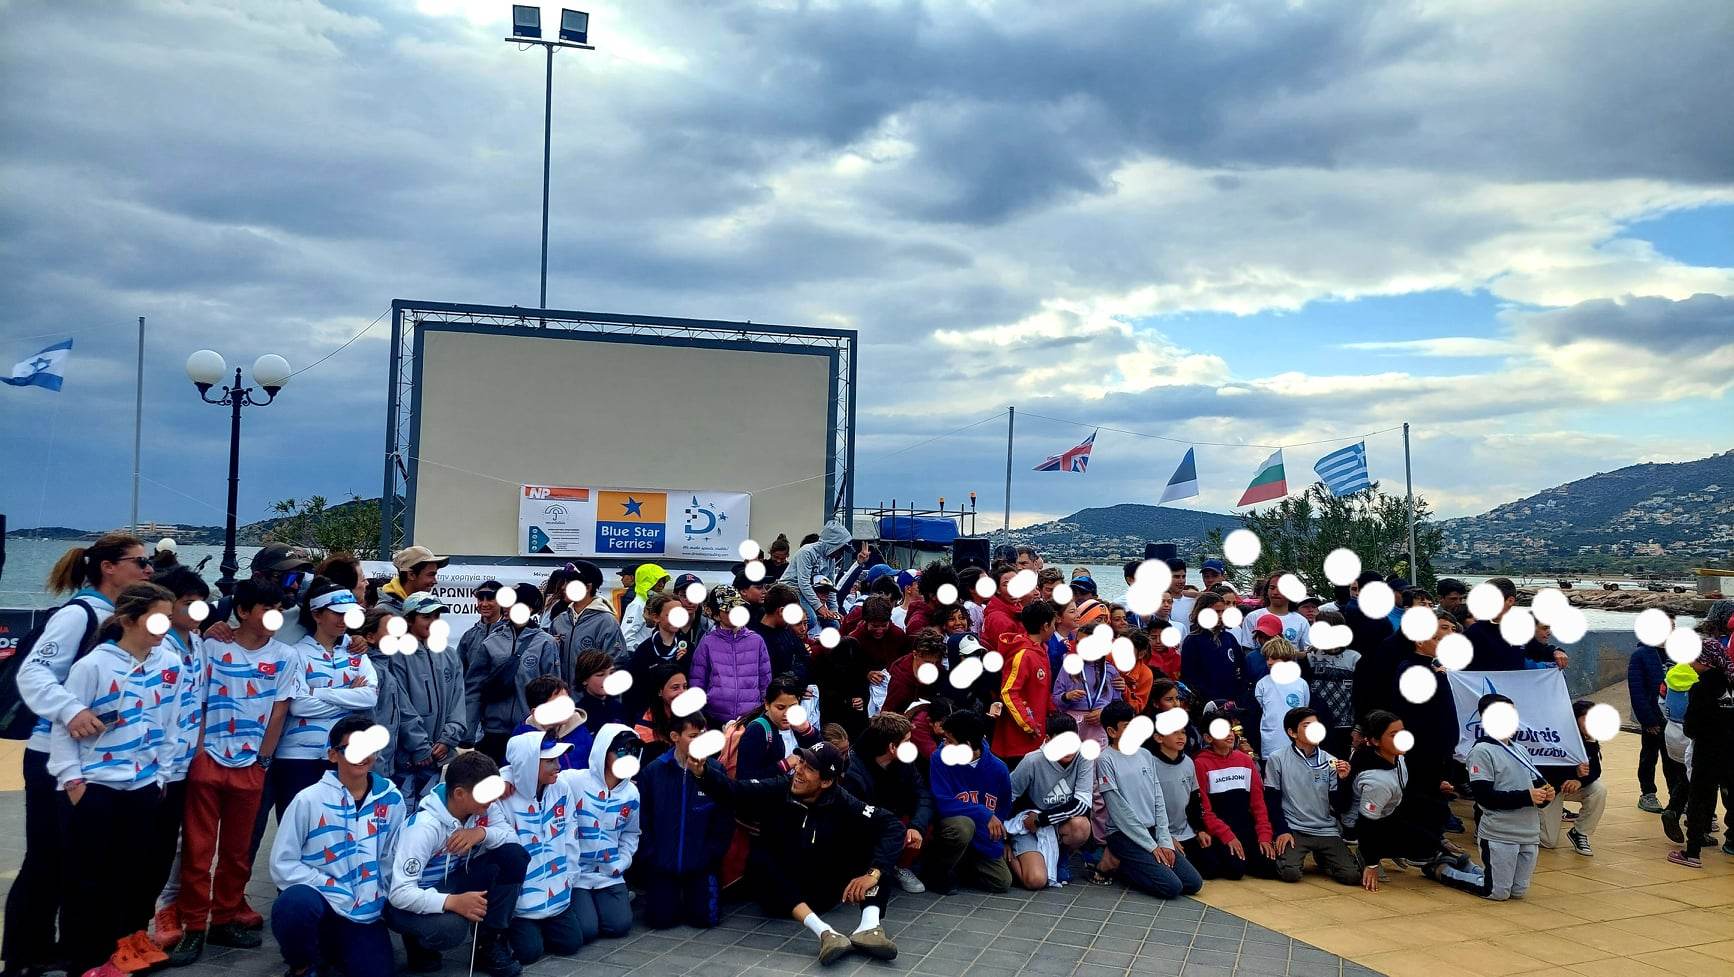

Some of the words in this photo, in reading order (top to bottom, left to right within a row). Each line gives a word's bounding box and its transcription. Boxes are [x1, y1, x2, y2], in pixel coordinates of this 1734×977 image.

[529, 487, 551, 500] NP
[601, 525, 630, 537] Blue
[634, 526, 660, 538] Star
[609, 538, 653, 549] Ferries
[431, 587, 478, 598] ΑΡΩΝΙΚ
